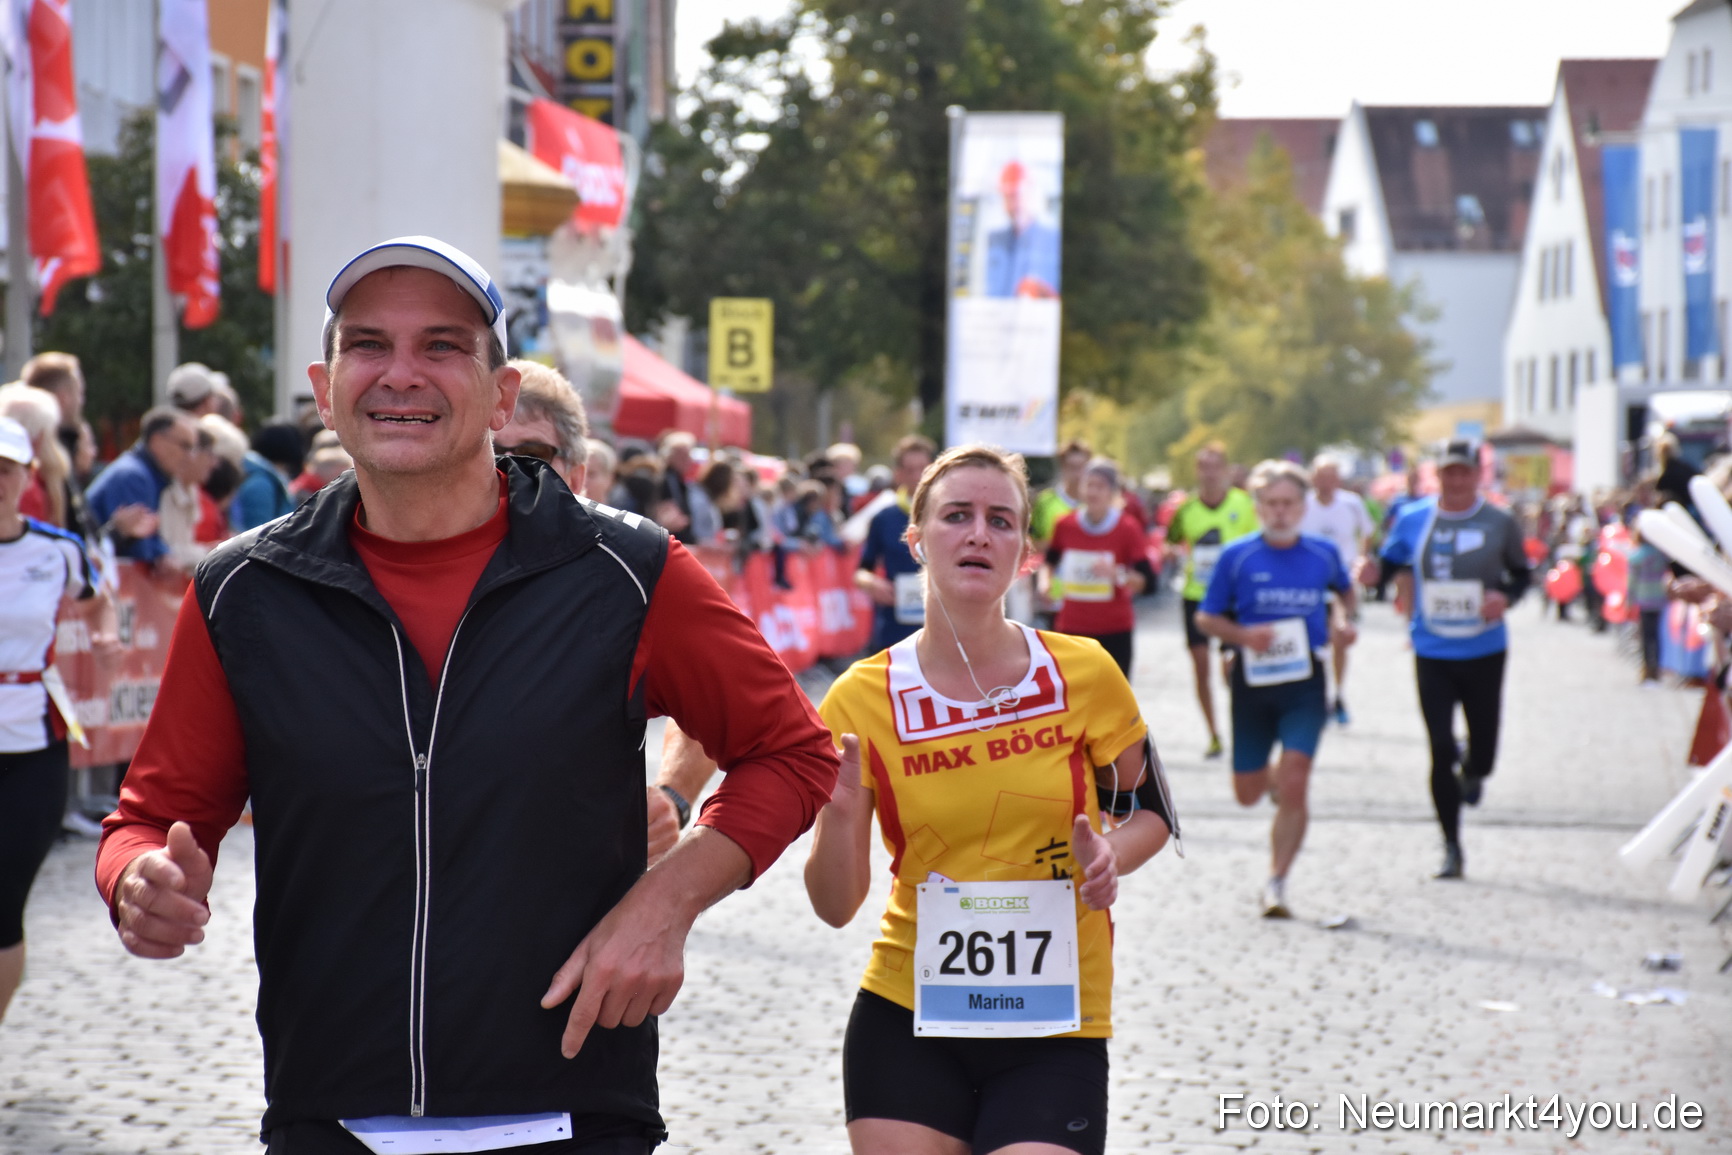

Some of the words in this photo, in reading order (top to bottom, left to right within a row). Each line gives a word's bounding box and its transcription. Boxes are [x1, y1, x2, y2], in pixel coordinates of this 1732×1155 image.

[727, 327, 755, 370] B
[902, 745, 977, 777] MAX
[986, 724, 1073, 762] BÖGL
[974, 896, 1030, 910] BOCK
[939, 930, 1052, 976] 2617
[924, 969, 930, 978] D
[969, 993, 1024, 1010] Marina
